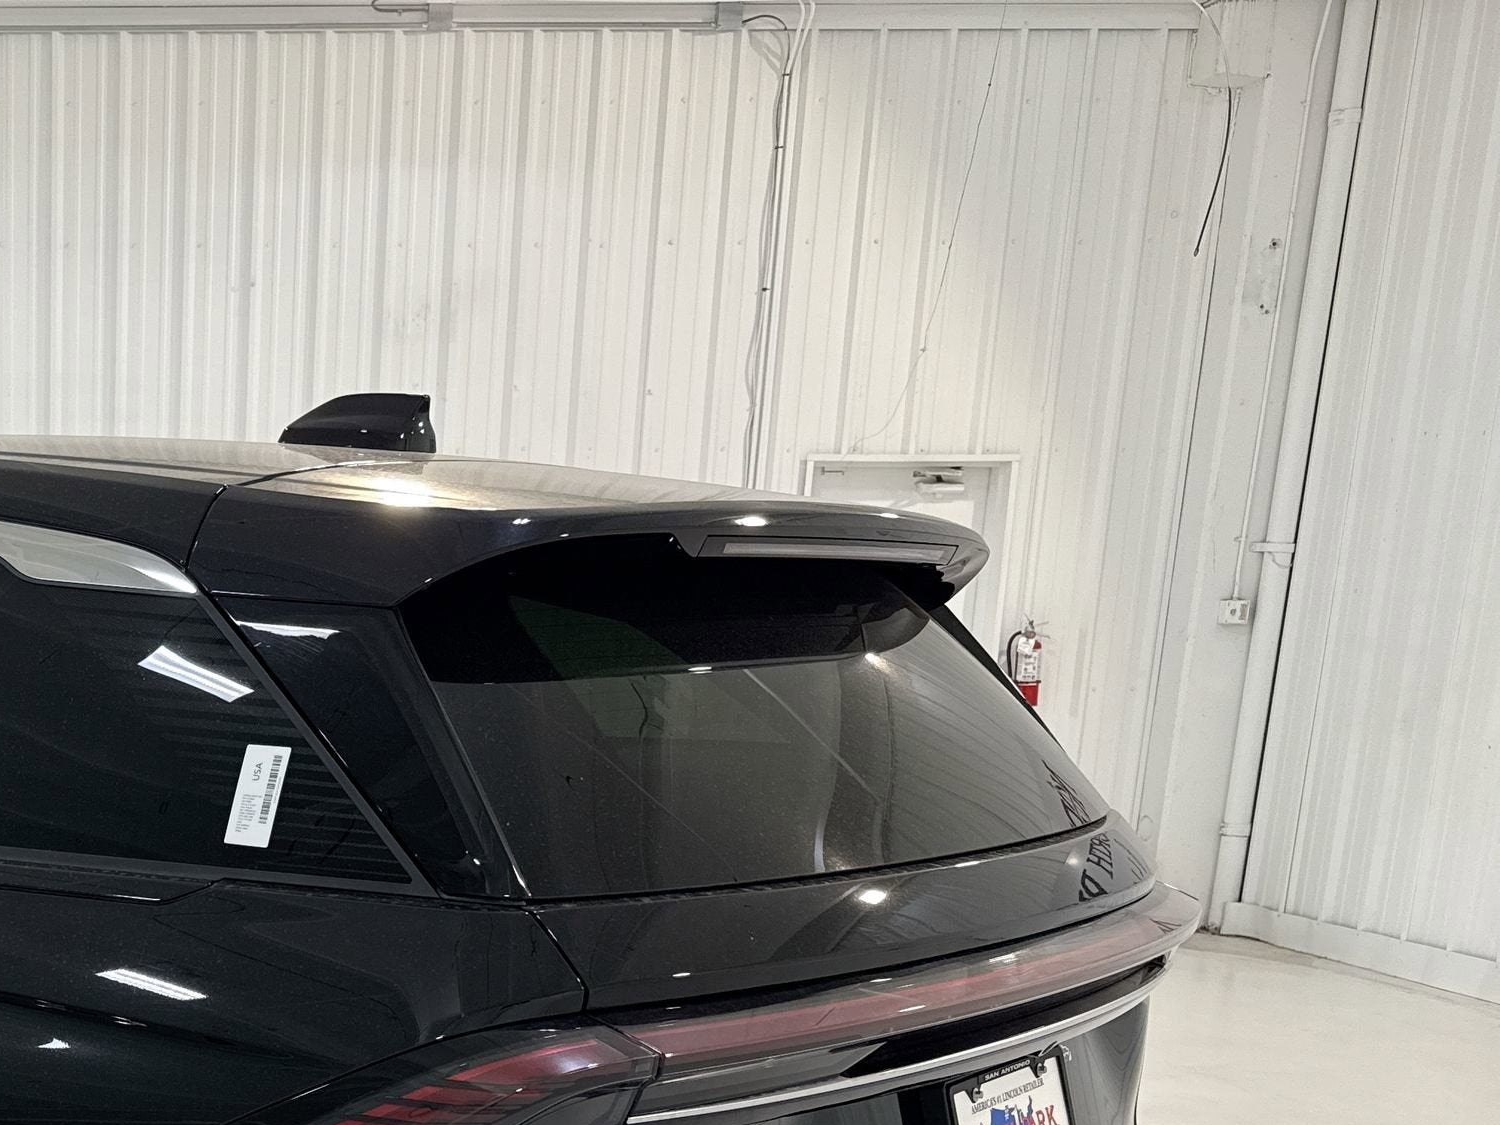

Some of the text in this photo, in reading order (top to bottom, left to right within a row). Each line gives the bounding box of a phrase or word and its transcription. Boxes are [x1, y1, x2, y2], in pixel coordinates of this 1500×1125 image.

[252, 762, 263, 781] USA
[984, 1059, 1031, 1081] SAN ANTONIO
[1002, 1085, 1024, 1102] LINCOLN
[1022, 1077, 1045, 1094] RETAILER
